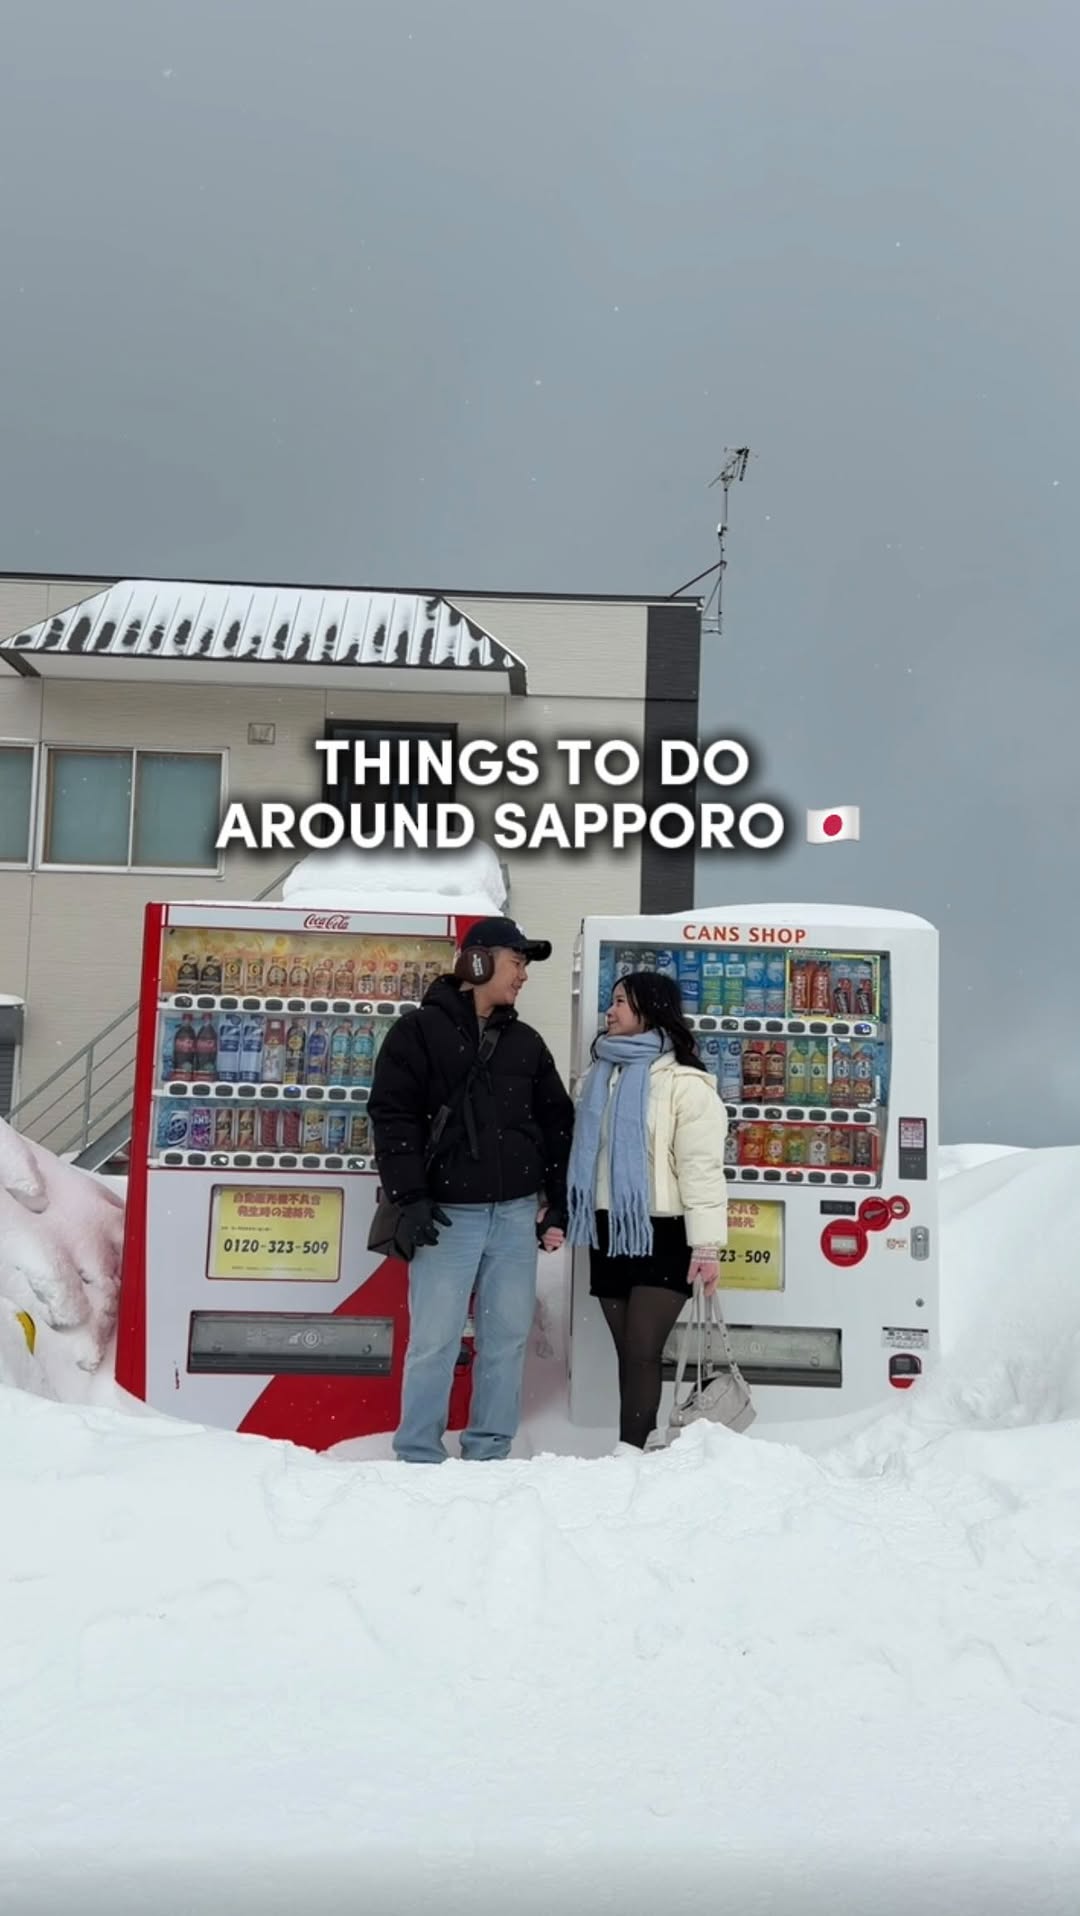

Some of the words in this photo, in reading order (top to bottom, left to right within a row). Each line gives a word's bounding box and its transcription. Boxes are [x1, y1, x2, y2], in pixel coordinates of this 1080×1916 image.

[683, 924, 740, 942] CANS
[748, 927, 806, 944] SHOP
[223, 1238, 329, 1255] 0120-323-509
